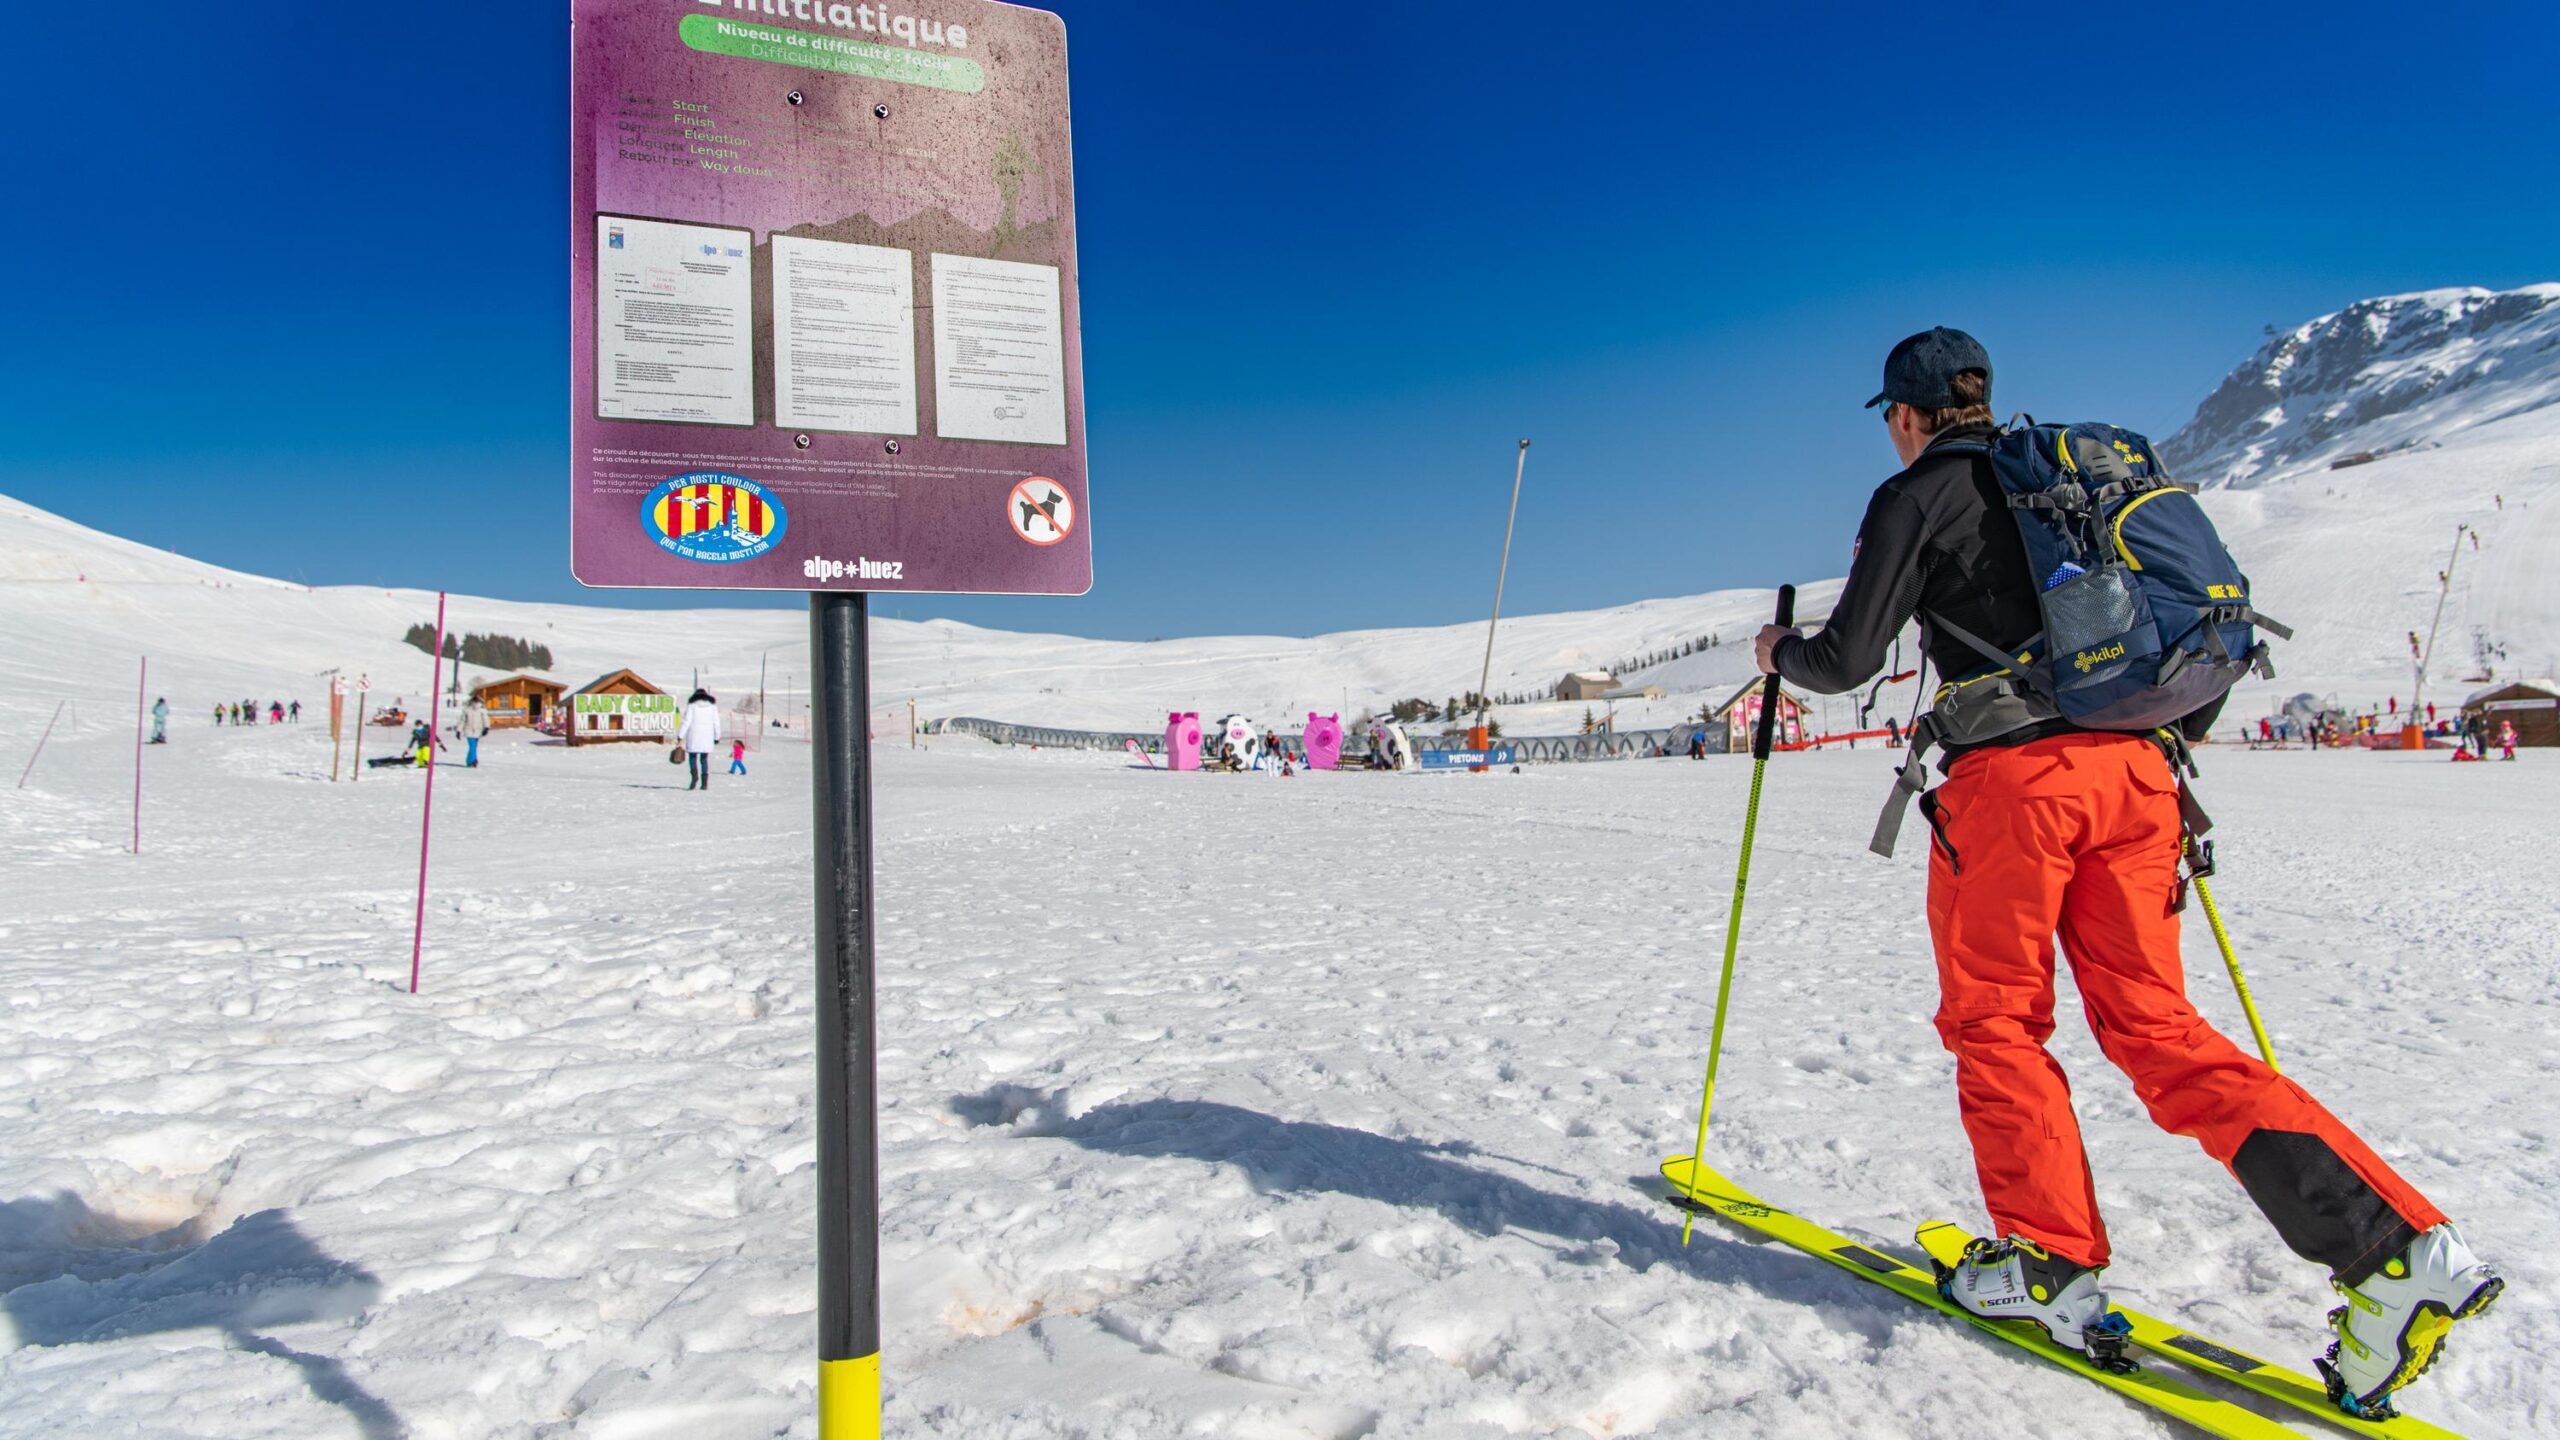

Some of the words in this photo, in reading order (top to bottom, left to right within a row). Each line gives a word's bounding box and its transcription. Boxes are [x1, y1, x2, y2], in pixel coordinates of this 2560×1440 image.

[717, 22, 781, 43] Niveau
[786, 34, 808, 47] de
[812, 38, 892, 60] difficulté
[751, 44, 830, 68] Difficulty
[672, 100, 708, 113] Start
[674, 114, 716, 128] Finish
[684, 129, 751, 146] Elevation
[690, 145, 738, 159] Length
[619, 149, 668, 164] Retour
[700, 160, 730, 174] Way
[734, 163, 773, 177] down
[639, 450, 679, 458] découverte
[609, 472, 643, 480] discovery
[669, 480, 688, 491] PER
[690, 474, 718, 484] NOSTI
[721, 476, 761, 495] COULOUR
[660, 536, 677, 550] QUE
[2091, 642, 2124, 663] kilpi
[576, 694, 625, 713] BABY
[627, 694, 674, 714] CLUB
[1448, 753, 1484, 763] PIETONS
[1987, 1296, 2026, 1306] SCOTT
